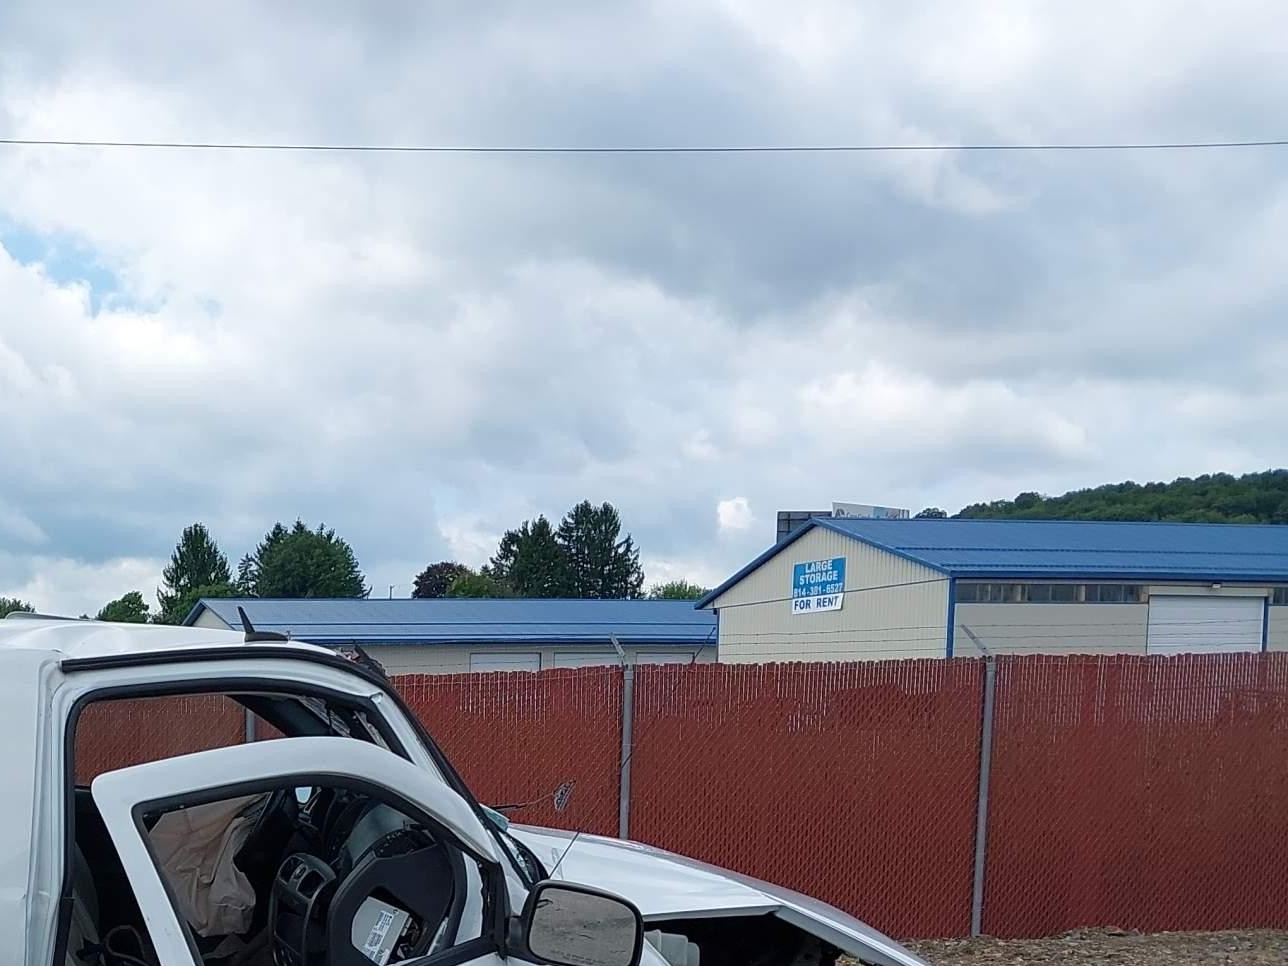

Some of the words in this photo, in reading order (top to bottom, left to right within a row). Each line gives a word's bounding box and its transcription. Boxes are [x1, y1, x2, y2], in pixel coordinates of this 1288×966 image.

[805, 560, 833, 573] LARGE
[799, 570, 839, 585] STORAGE
[794, 599, 812, 611] FOR
[816, 596, 840, 609] RENT
